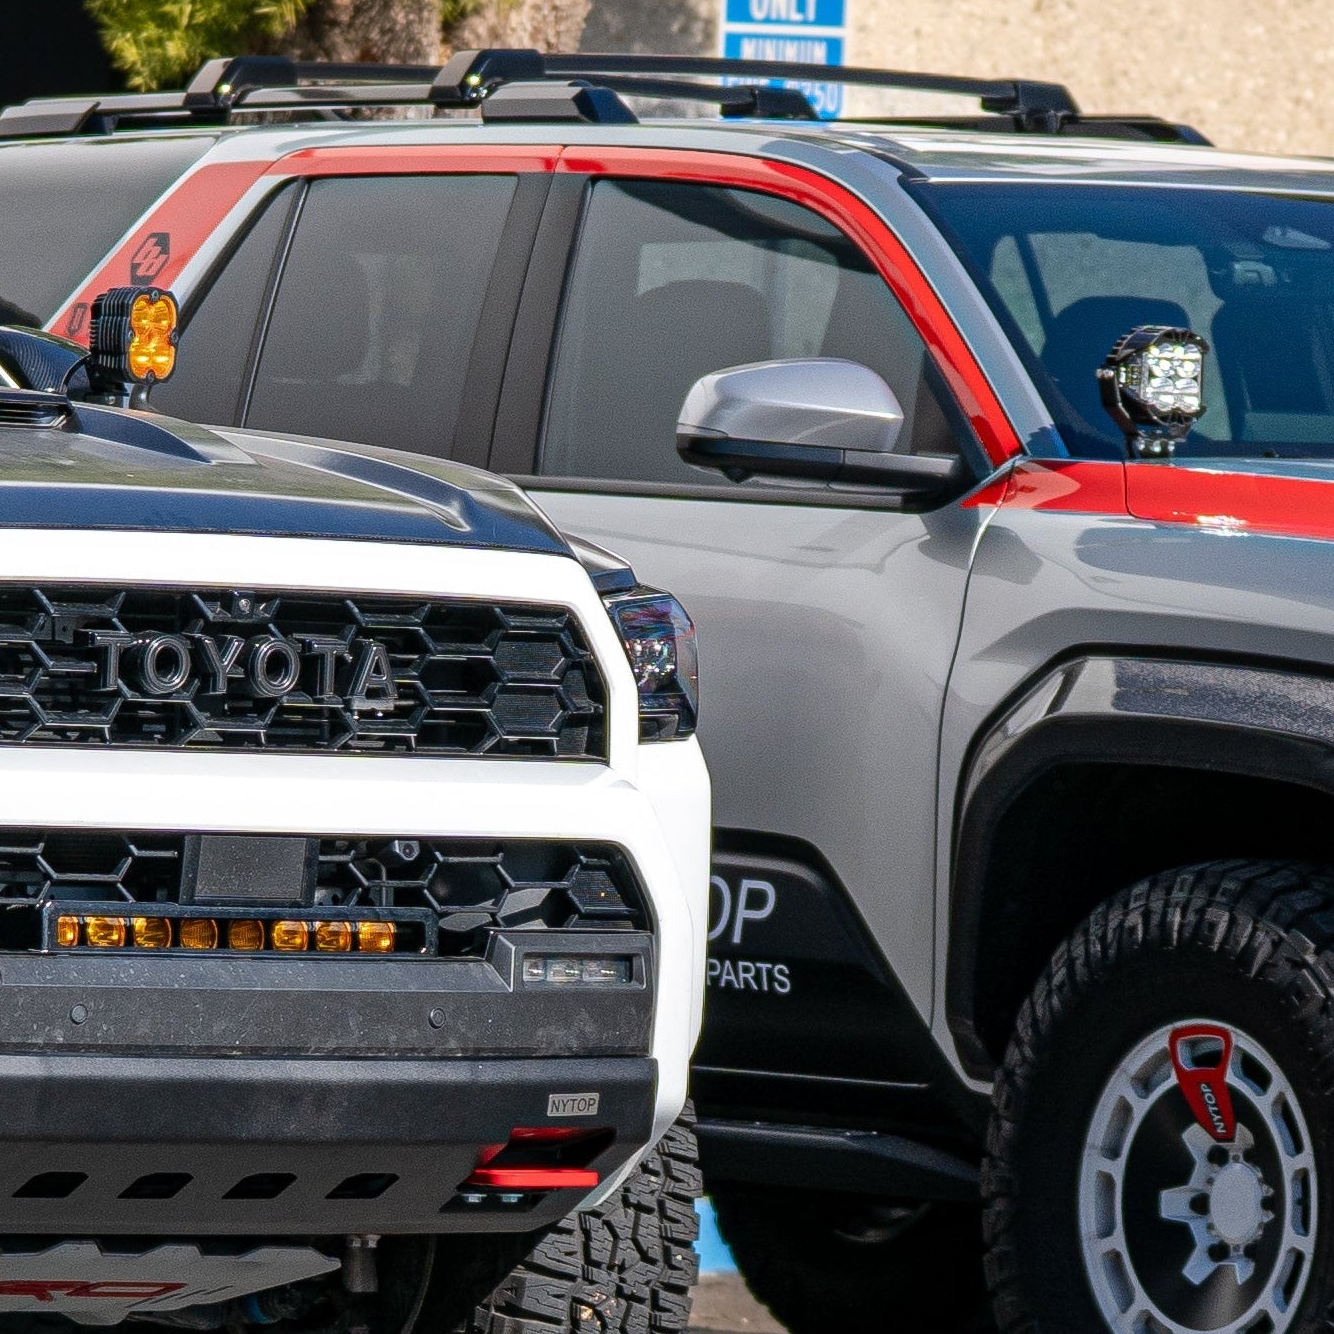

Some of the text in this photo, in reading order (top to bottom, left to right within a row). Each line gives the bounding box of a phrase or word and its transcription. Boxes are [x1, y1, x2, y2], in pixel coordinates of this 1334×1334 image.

[75, 629, 400, 700] TOYOTA
[707, 958, 791, 993] PARTS
[550, 1097, 597, 1113] NYTOP
[1199, 1083, 1227, 1134] NYTOP
